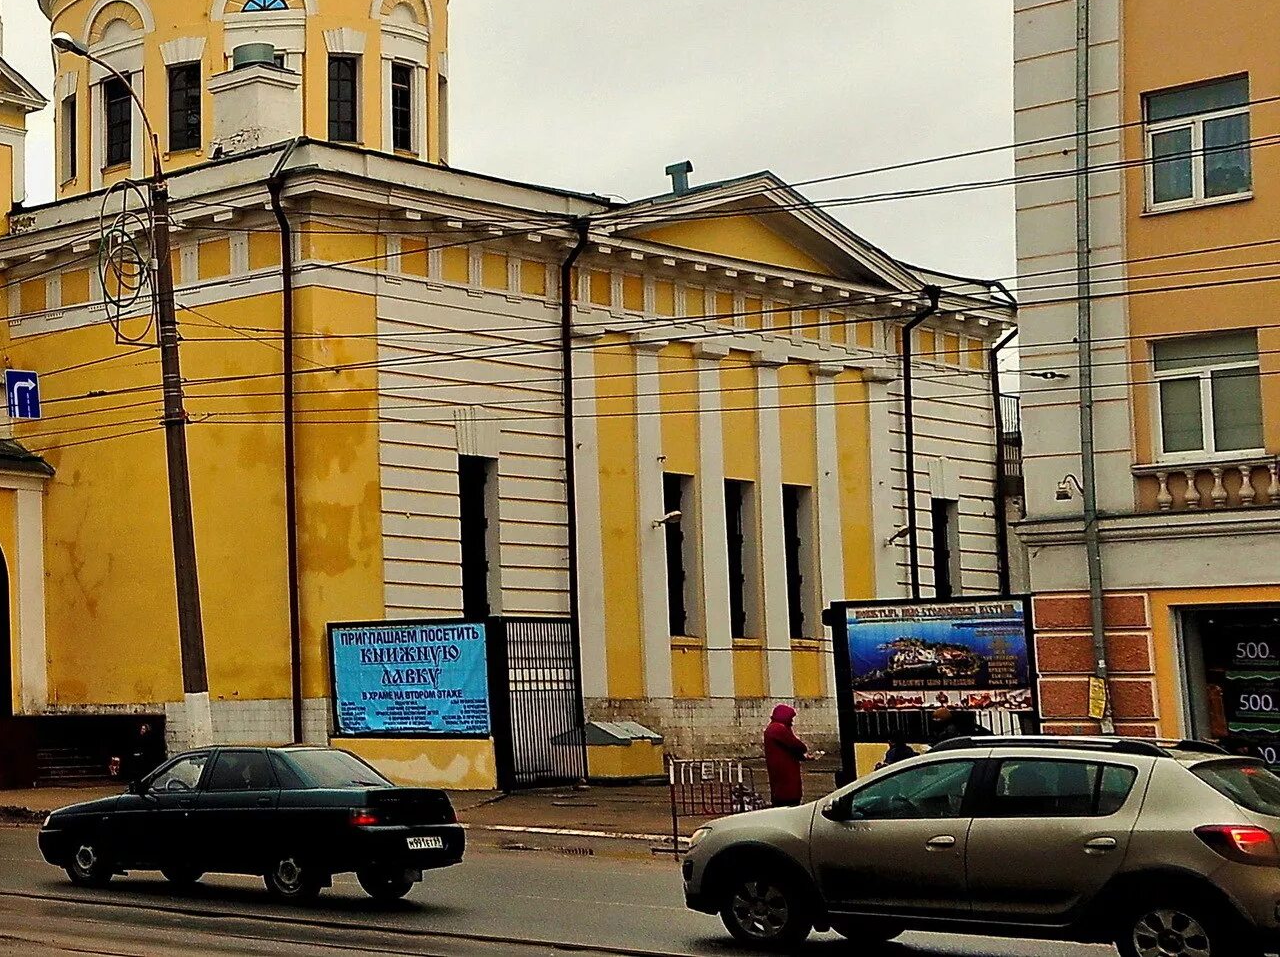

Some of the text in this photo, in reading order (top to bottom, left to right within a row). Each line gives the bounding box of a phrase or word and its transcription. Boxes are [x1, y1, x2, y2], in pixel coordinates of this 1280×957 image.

[340, 627, 479, 645] ПРИГЛАШАЕМ ПОСЕТИТЬ
[360, 644, 461, 666] КНИЖНУЮ
[1236, 642, 1270, 659] 500
[381, 668, 442, 689] ЛАВКУ
[362, 688, 463, 700] В ХРАМЕ НА ВТОРОМ ЭТАЖЕ
[1239, 694, 1273, 711] 500
